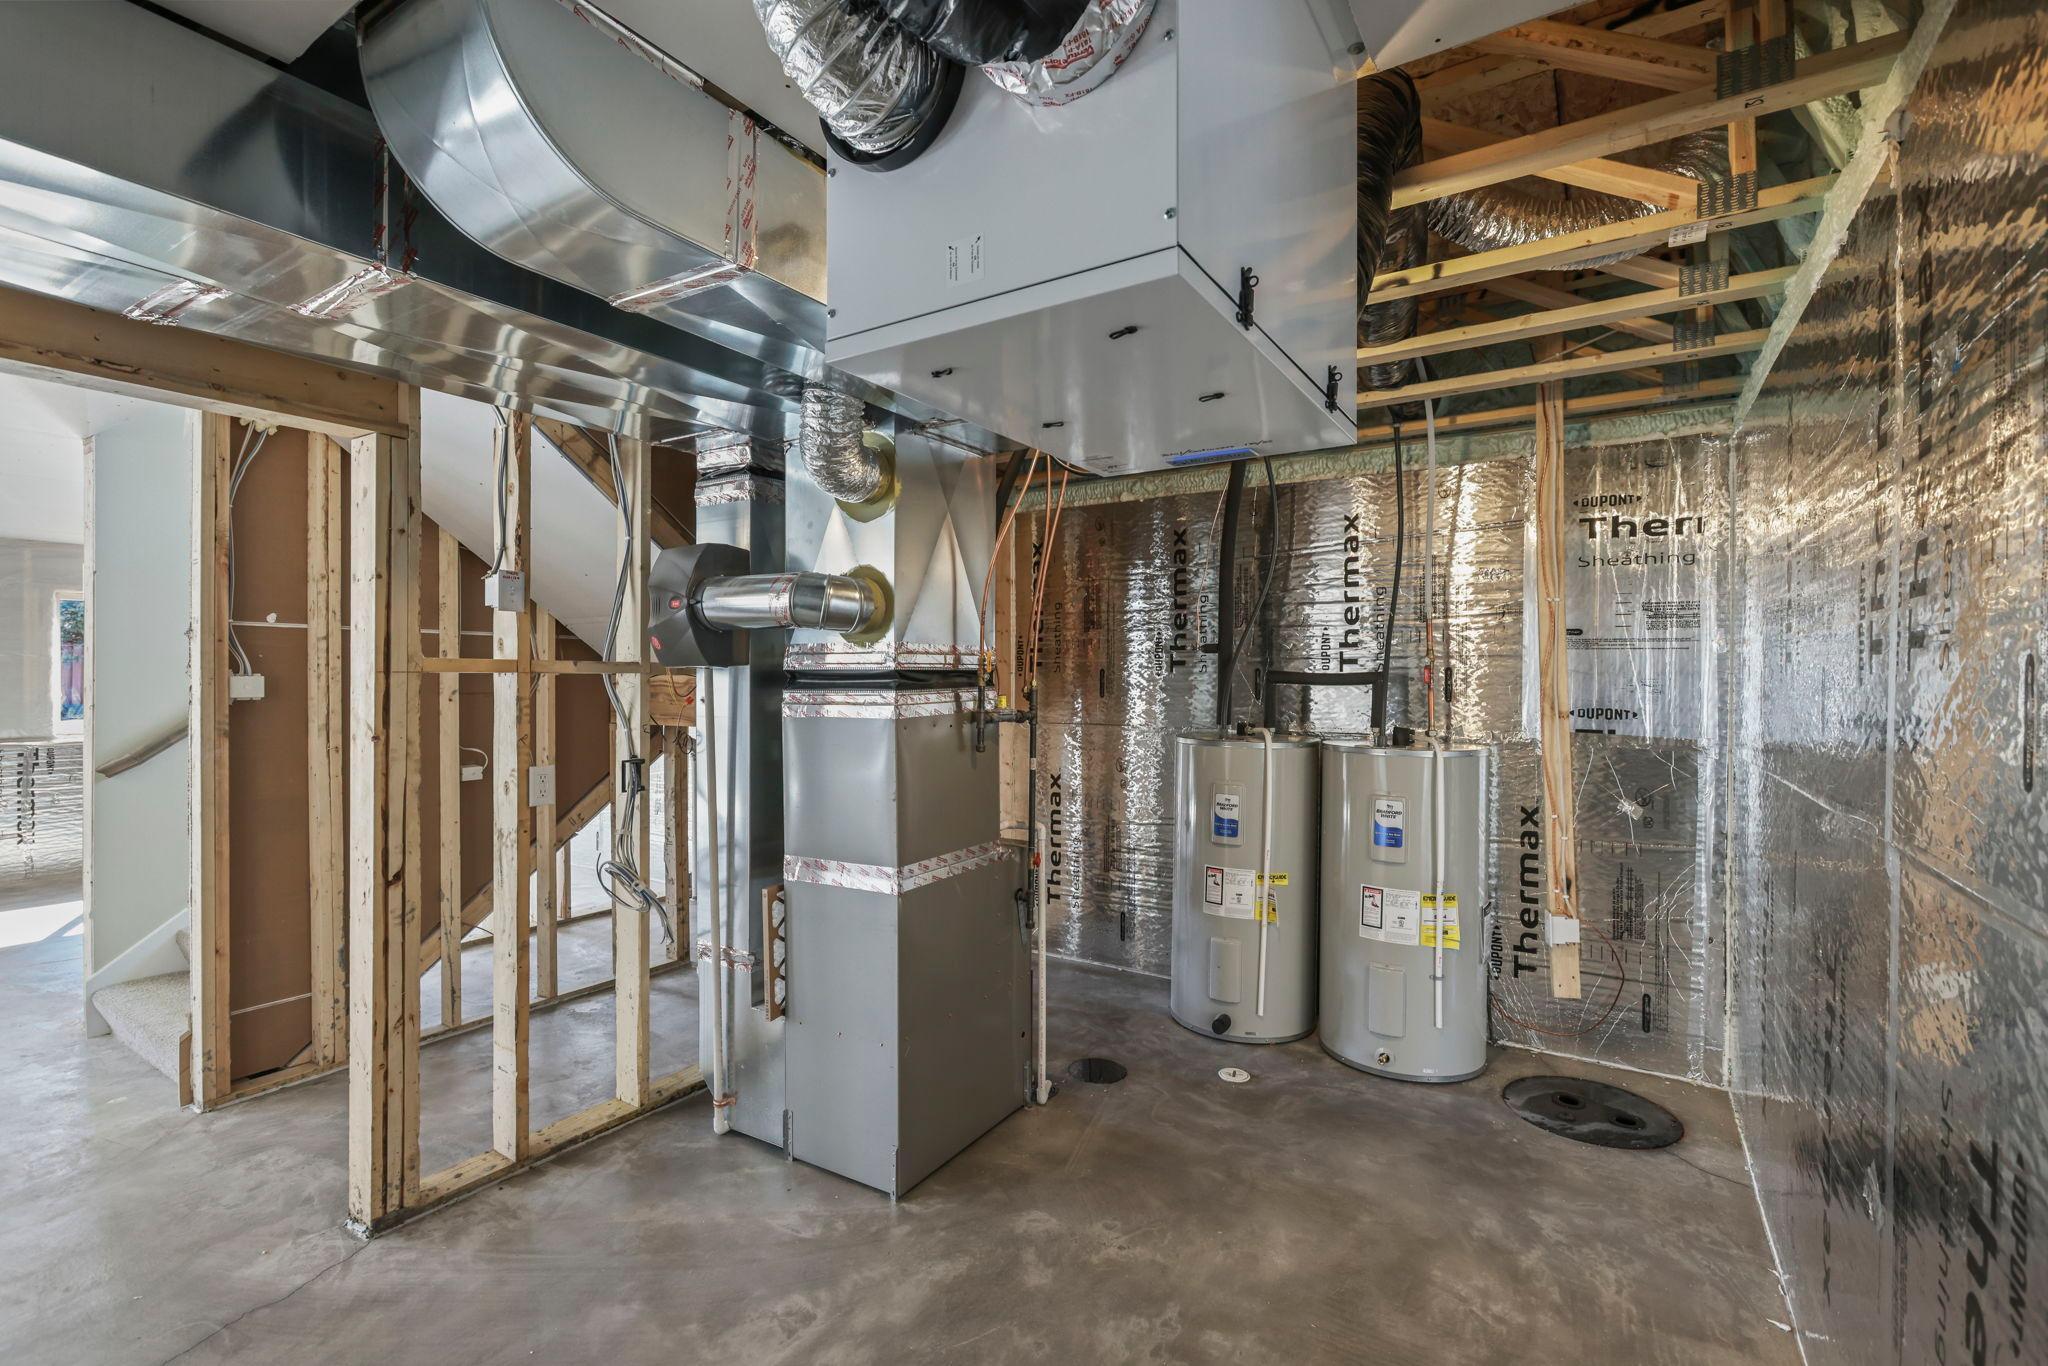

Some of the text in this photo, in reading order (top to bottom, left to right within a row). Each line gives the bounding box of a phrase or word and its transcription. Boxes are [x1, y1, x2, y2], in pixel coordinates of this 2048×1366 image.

[1581, 494, 1635, 507] DUPONT
[1339, 513, 1359, 672] Thermax
[1578, 553, 1696, 568] Sheathing
[1170, 528, 1187, 673] Thermax
[1198, 594, 1209, 673] Shathing
[1374, 586, 1387, 672] Sheathing
[1053, 602, 1062, 673] Sheathing
[1154, 636, 1163, 671] DUPONT
[1321, 632, 1331, 671] DUPONT
[1578, 708, 1630, 721] DUPONT
[1047, 772, 1061, 905] Thermax
[1071, 838, 1081, 908] Sheathing
[1513, 806, 1539, 978] Thermax
[1491, 931, 1503, 974] DUPONT
[2009, 1174, 2029, 1340] DUPONT
